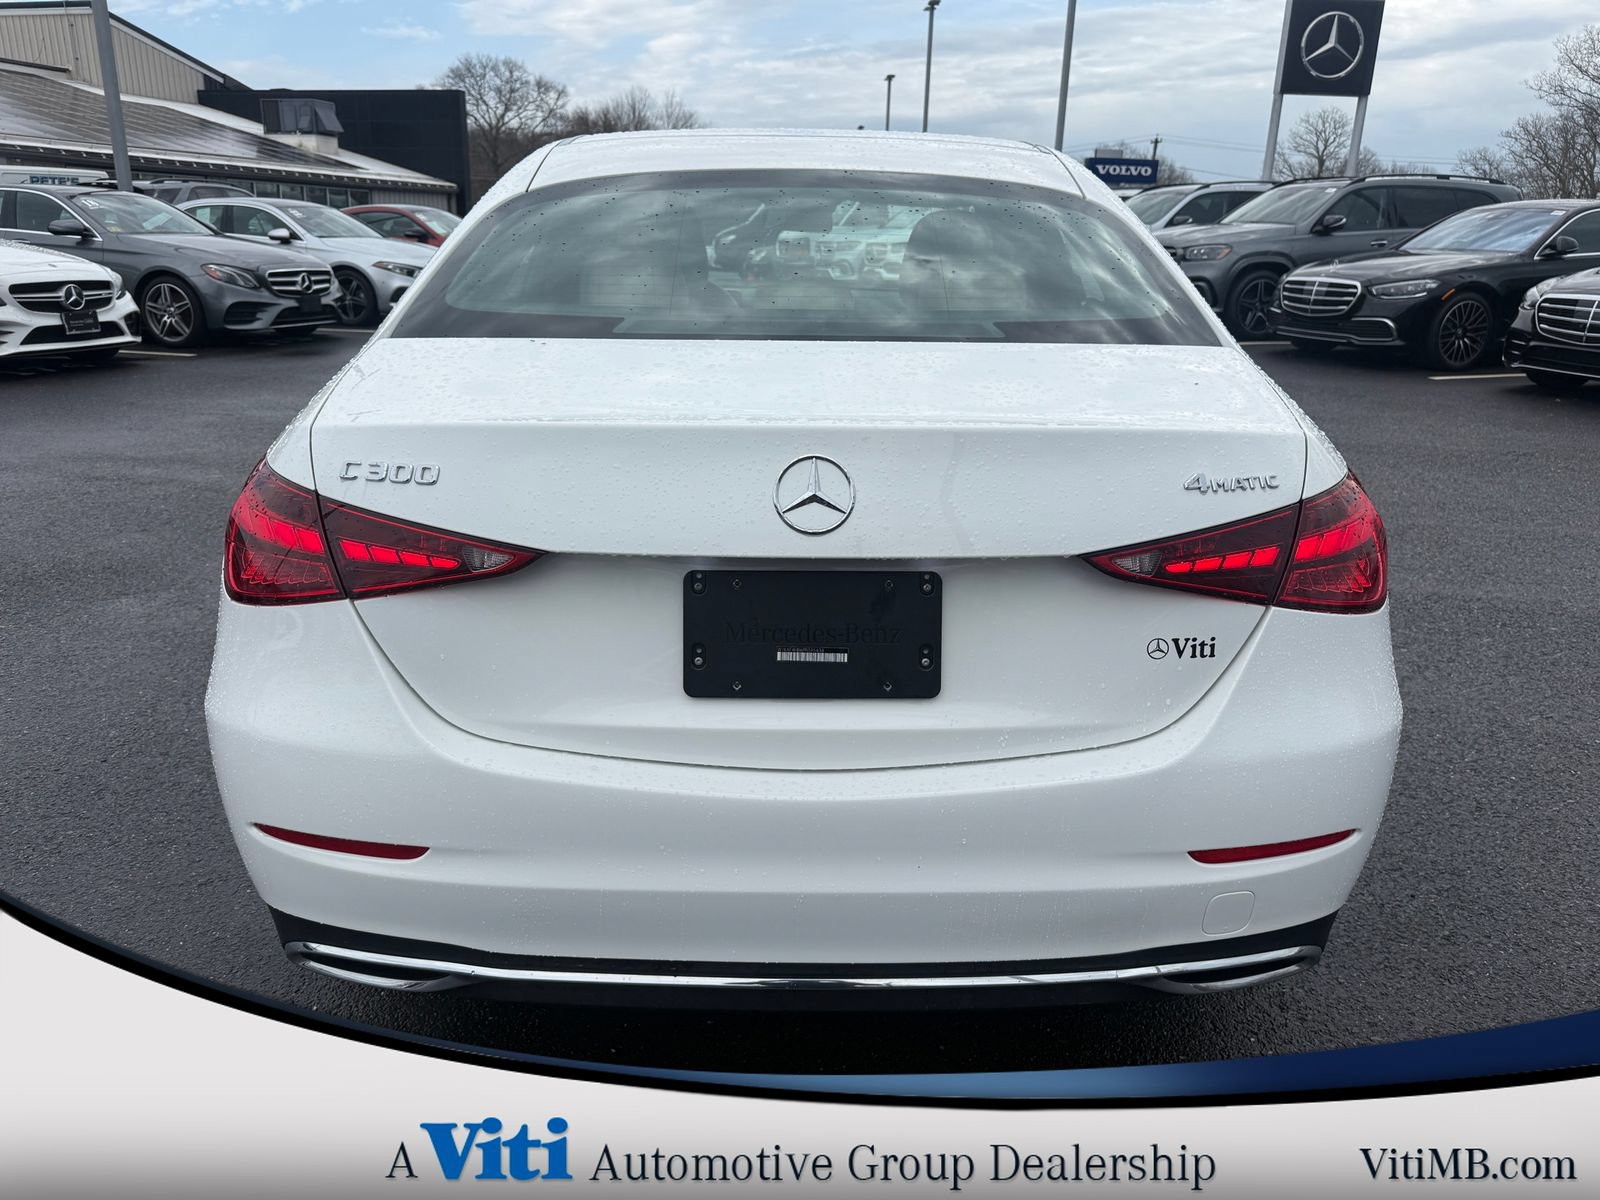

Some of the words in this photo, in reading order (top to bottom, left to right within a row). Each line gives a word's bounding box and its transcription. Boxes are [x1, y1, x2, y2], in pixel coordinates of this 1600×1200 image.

[29, 175, 80, 185] PETE'S
[1096, 164, 1153, 177] VOLVO
[1183, 472, 1281, 494] 4MATIC
[724, 621, 903, 644] Mercedes-Benz
[1171, 636, 1217, 660] Viti
